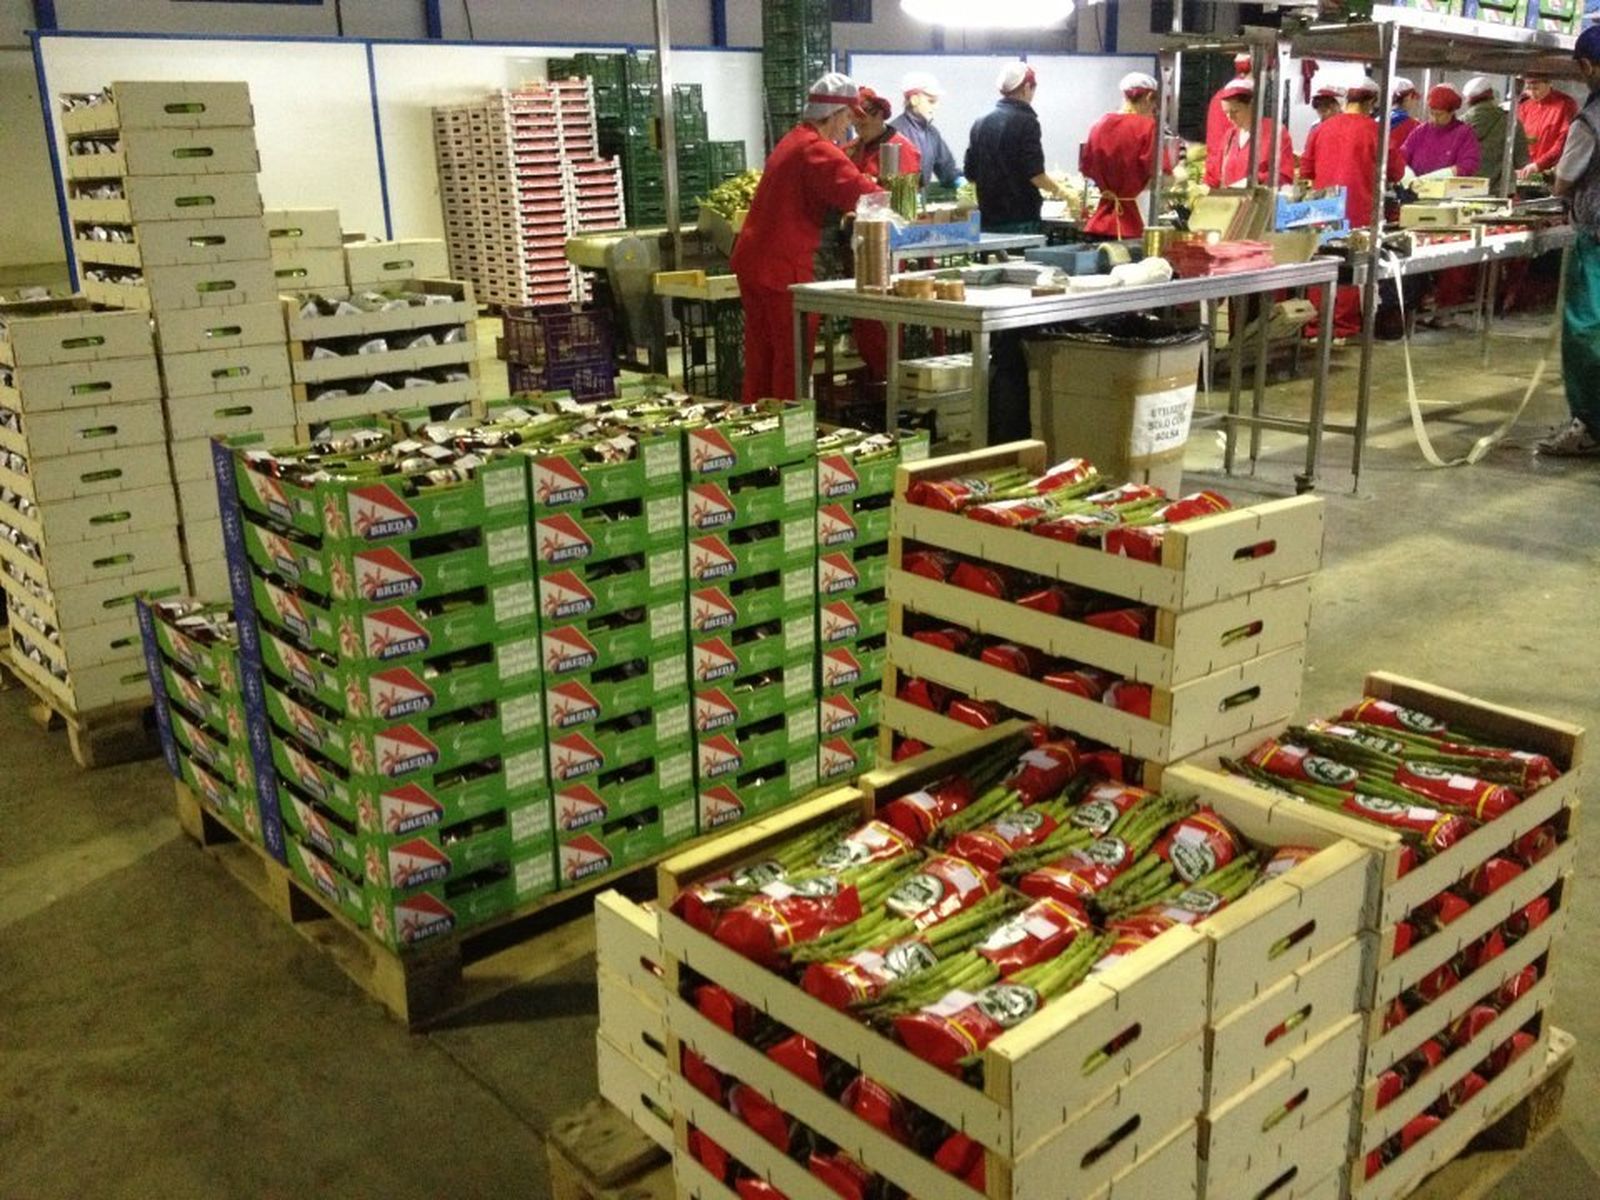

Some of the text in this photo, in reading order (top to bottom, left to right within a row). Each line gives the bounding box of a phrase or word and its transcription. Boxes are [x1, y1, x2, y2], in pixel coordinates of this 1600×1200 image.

[703, 455, 733, 470] BREDA
[549, 488, 585, 503] BREDA
[370, 517, 414, 536] BREDA
[702, 511, 733, 525] BREDA
[376, 579, 419, 596] BREDA
[556, 600, 591, 616] BREDA
[384, 638, 426, 656] BREDA
[559, 654, 593, 671] BREDA
[389, 697, 431, 715] BREDA
[563, 709, 597, 726] BREDA
[394, 754, 434, 773] BREDA
[566, 760, 600, 777] BREDA
[399, 811, 439, 832] BREDA
[570, 810, 604, 828] BREDA
[408, 865, 447, 886] BREDA
[576, 859, 608, 877] BREDA
[413, 918, 451, 939] BREDA
